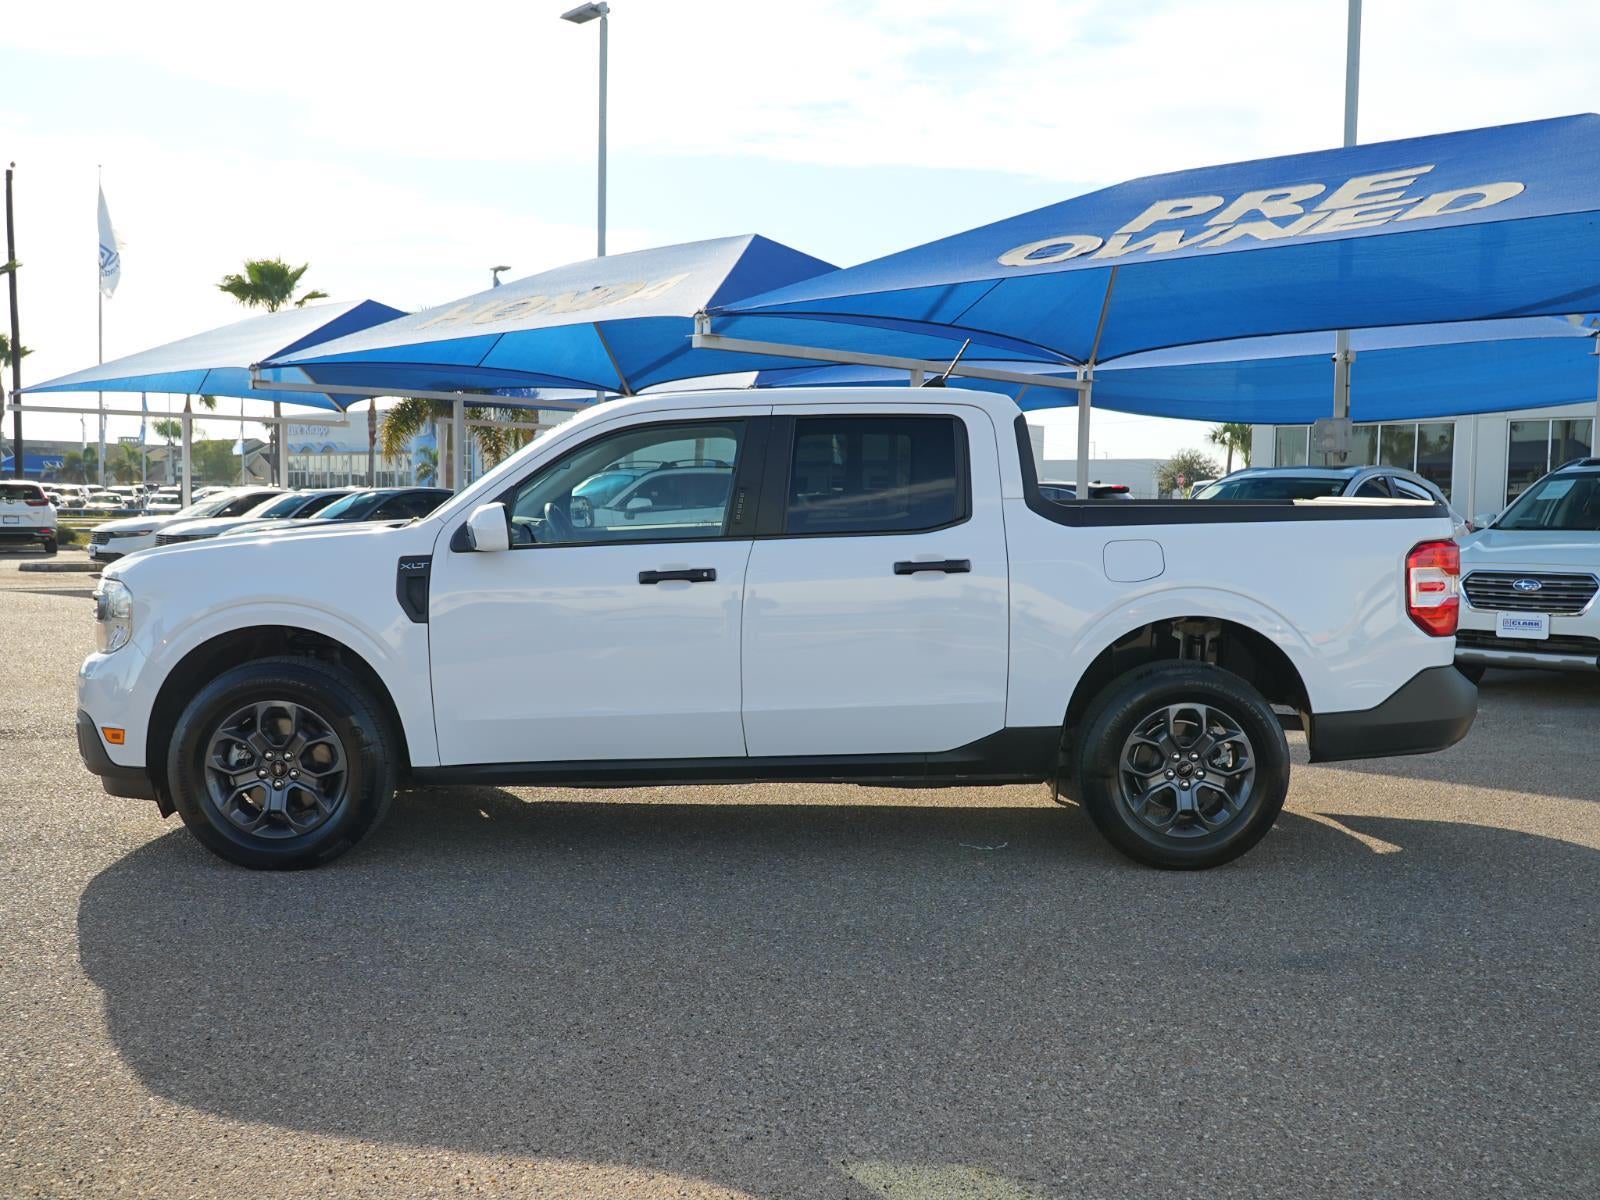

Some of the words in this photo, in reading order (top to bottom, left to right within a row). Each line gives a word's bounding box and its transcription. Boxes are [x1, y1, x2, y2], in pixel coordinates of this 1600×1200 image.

[997, 181, 1526, 267] OWNED
[1114, 164, 1436, 235] PRE
[400, 562, 430, 570] XLT
